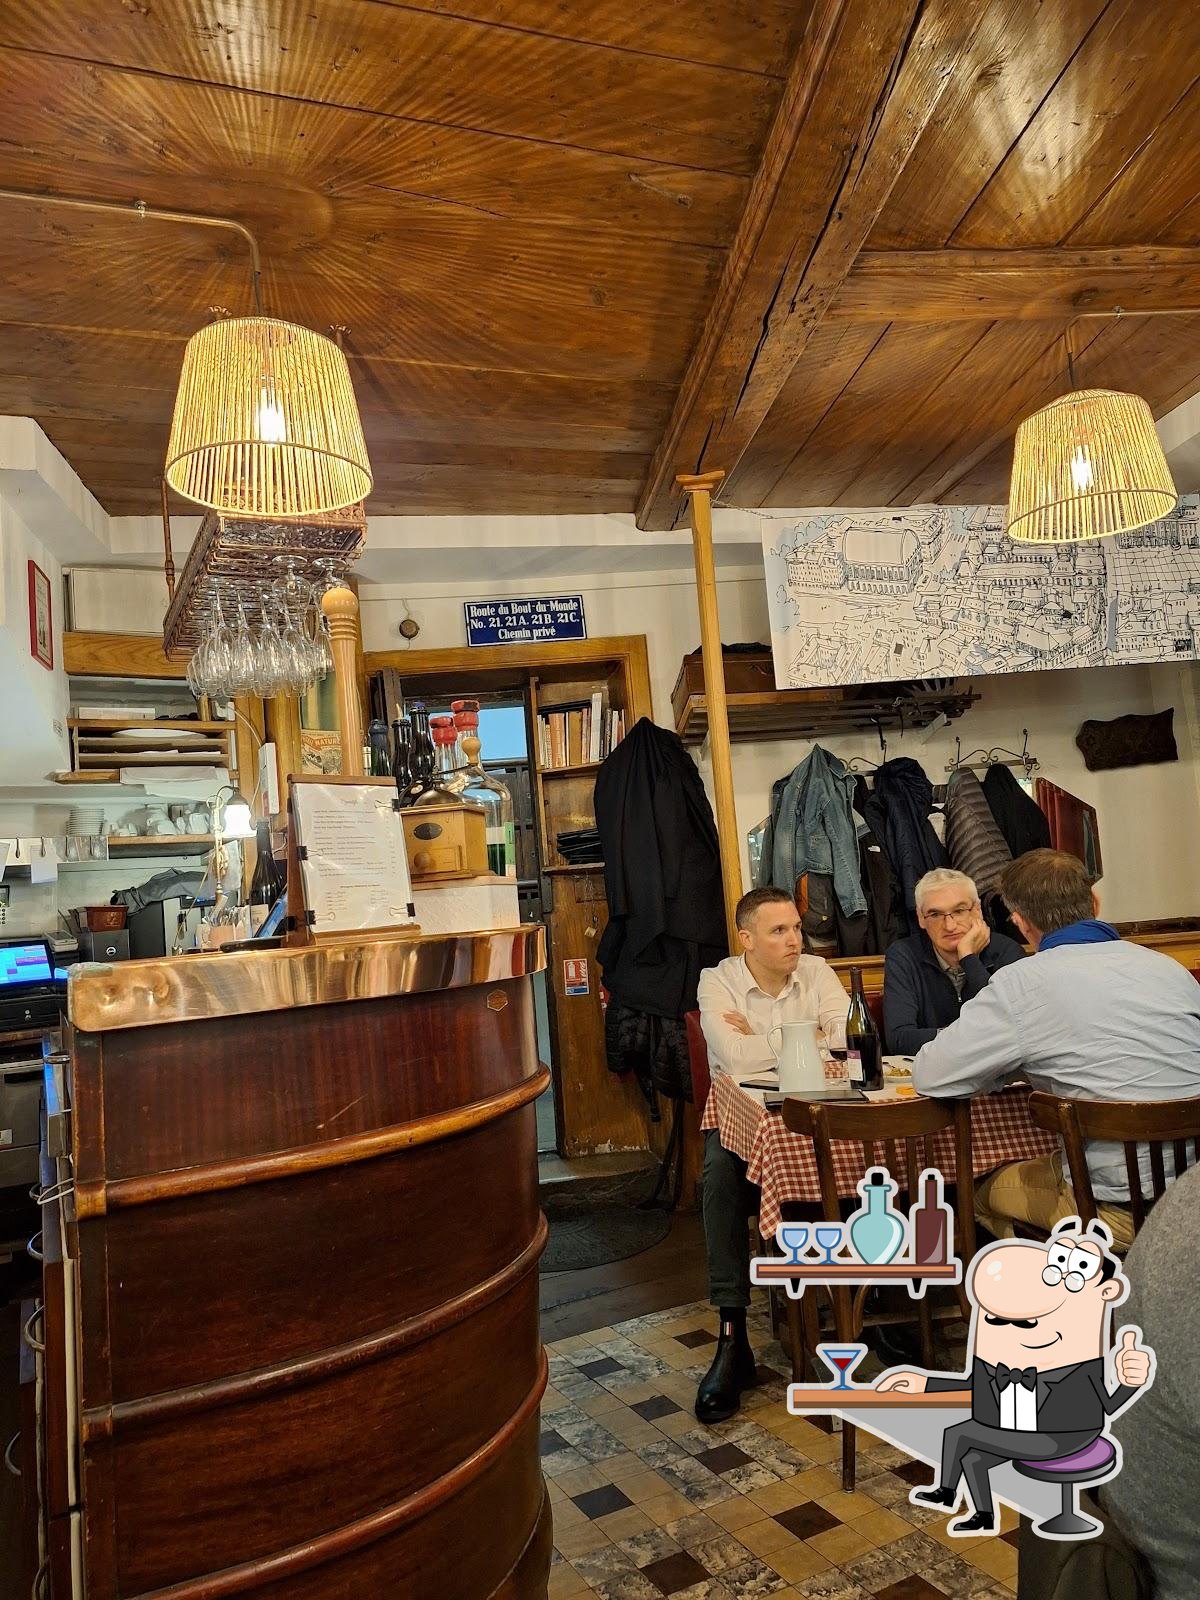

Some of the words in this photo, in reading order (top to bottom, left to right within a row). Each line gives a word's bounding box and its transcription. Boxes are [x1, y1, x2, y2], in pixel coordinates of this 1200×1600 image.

[470, 605, 495, 618] Route
[498, 604, 509, 615] du
[470, 619, 486, 630] No.
[489, 617, 503, 628] 21.
[498, 628, 531, 640] Chemin
[533, 626, 556, 641] privé
